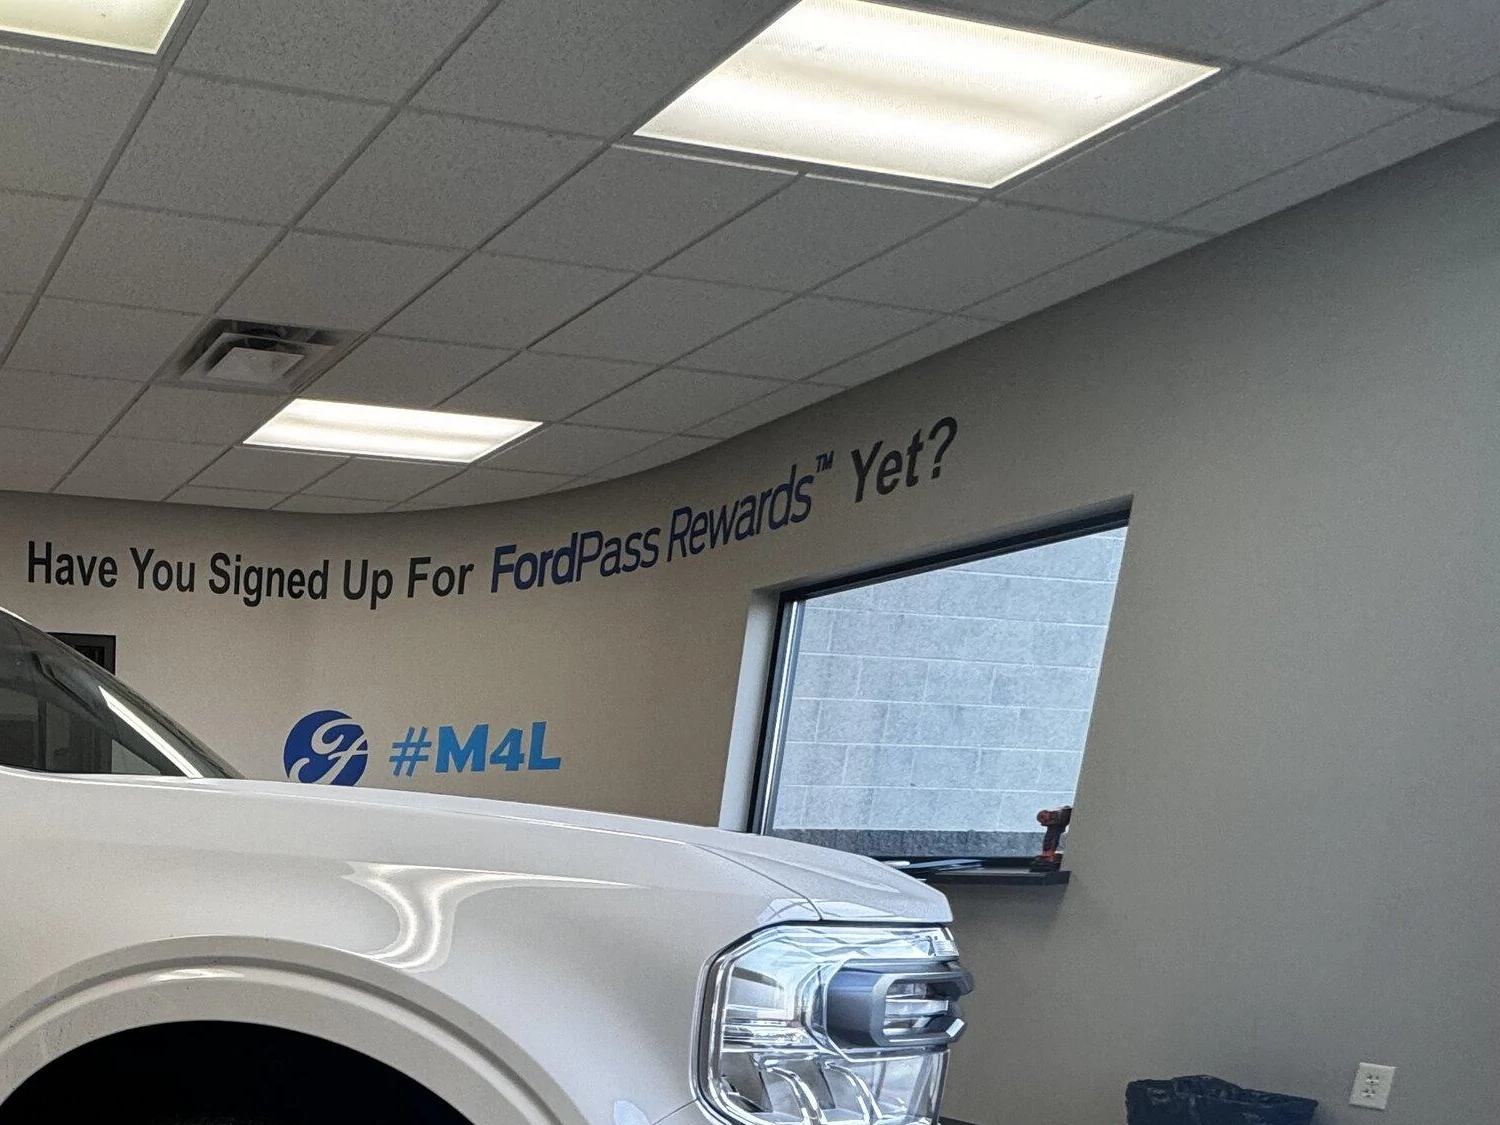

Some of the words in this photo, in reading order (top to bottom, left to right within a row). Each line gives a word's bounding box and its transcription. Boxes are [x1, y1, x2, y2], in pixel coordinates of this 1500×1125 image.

[27, 539, 118, 588] Have
[129, 547, 196, 593] You
[208, 552, 330, 608] Signed
[343, 558, 394, 611] Up
[406, 555, 475, 599] For
[490, 522, 662, 594] FordPass
[850, 416, 958, 503] Yet?
[388, 720, 562, 777] #M4L
